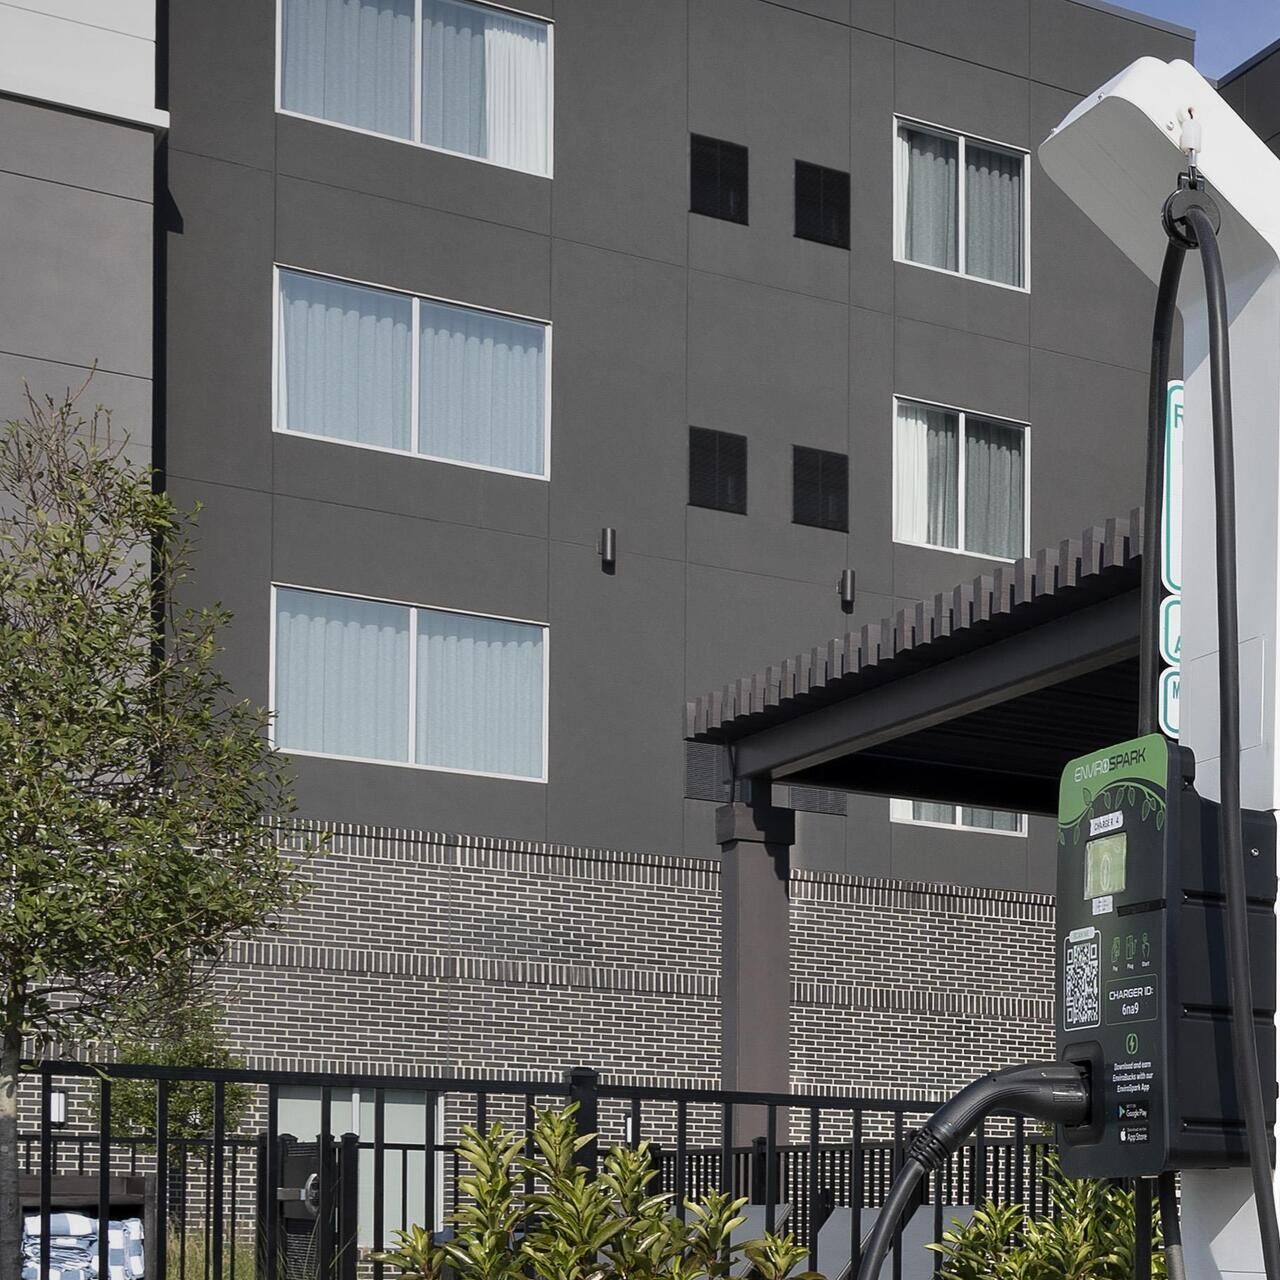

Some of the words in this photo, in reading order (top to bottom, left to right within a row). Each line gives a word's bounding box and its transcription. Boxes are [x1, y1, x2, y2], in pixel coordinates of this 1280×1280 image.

[1074, 748, 1146, 782] ENVIROSPARK
[1108, 987, 1143, 1001] CHARGER
[1144, 986, 1154, 996] ID:
[1121, 1001, 1139, 1016] 6na9
[1141, 1083, 1150, 1093] App
[1126, 1109, 1139, 1118] Google
[1127, 1133, 1136, 1143] App
[1136, 1132, 1148, 1141] Store
